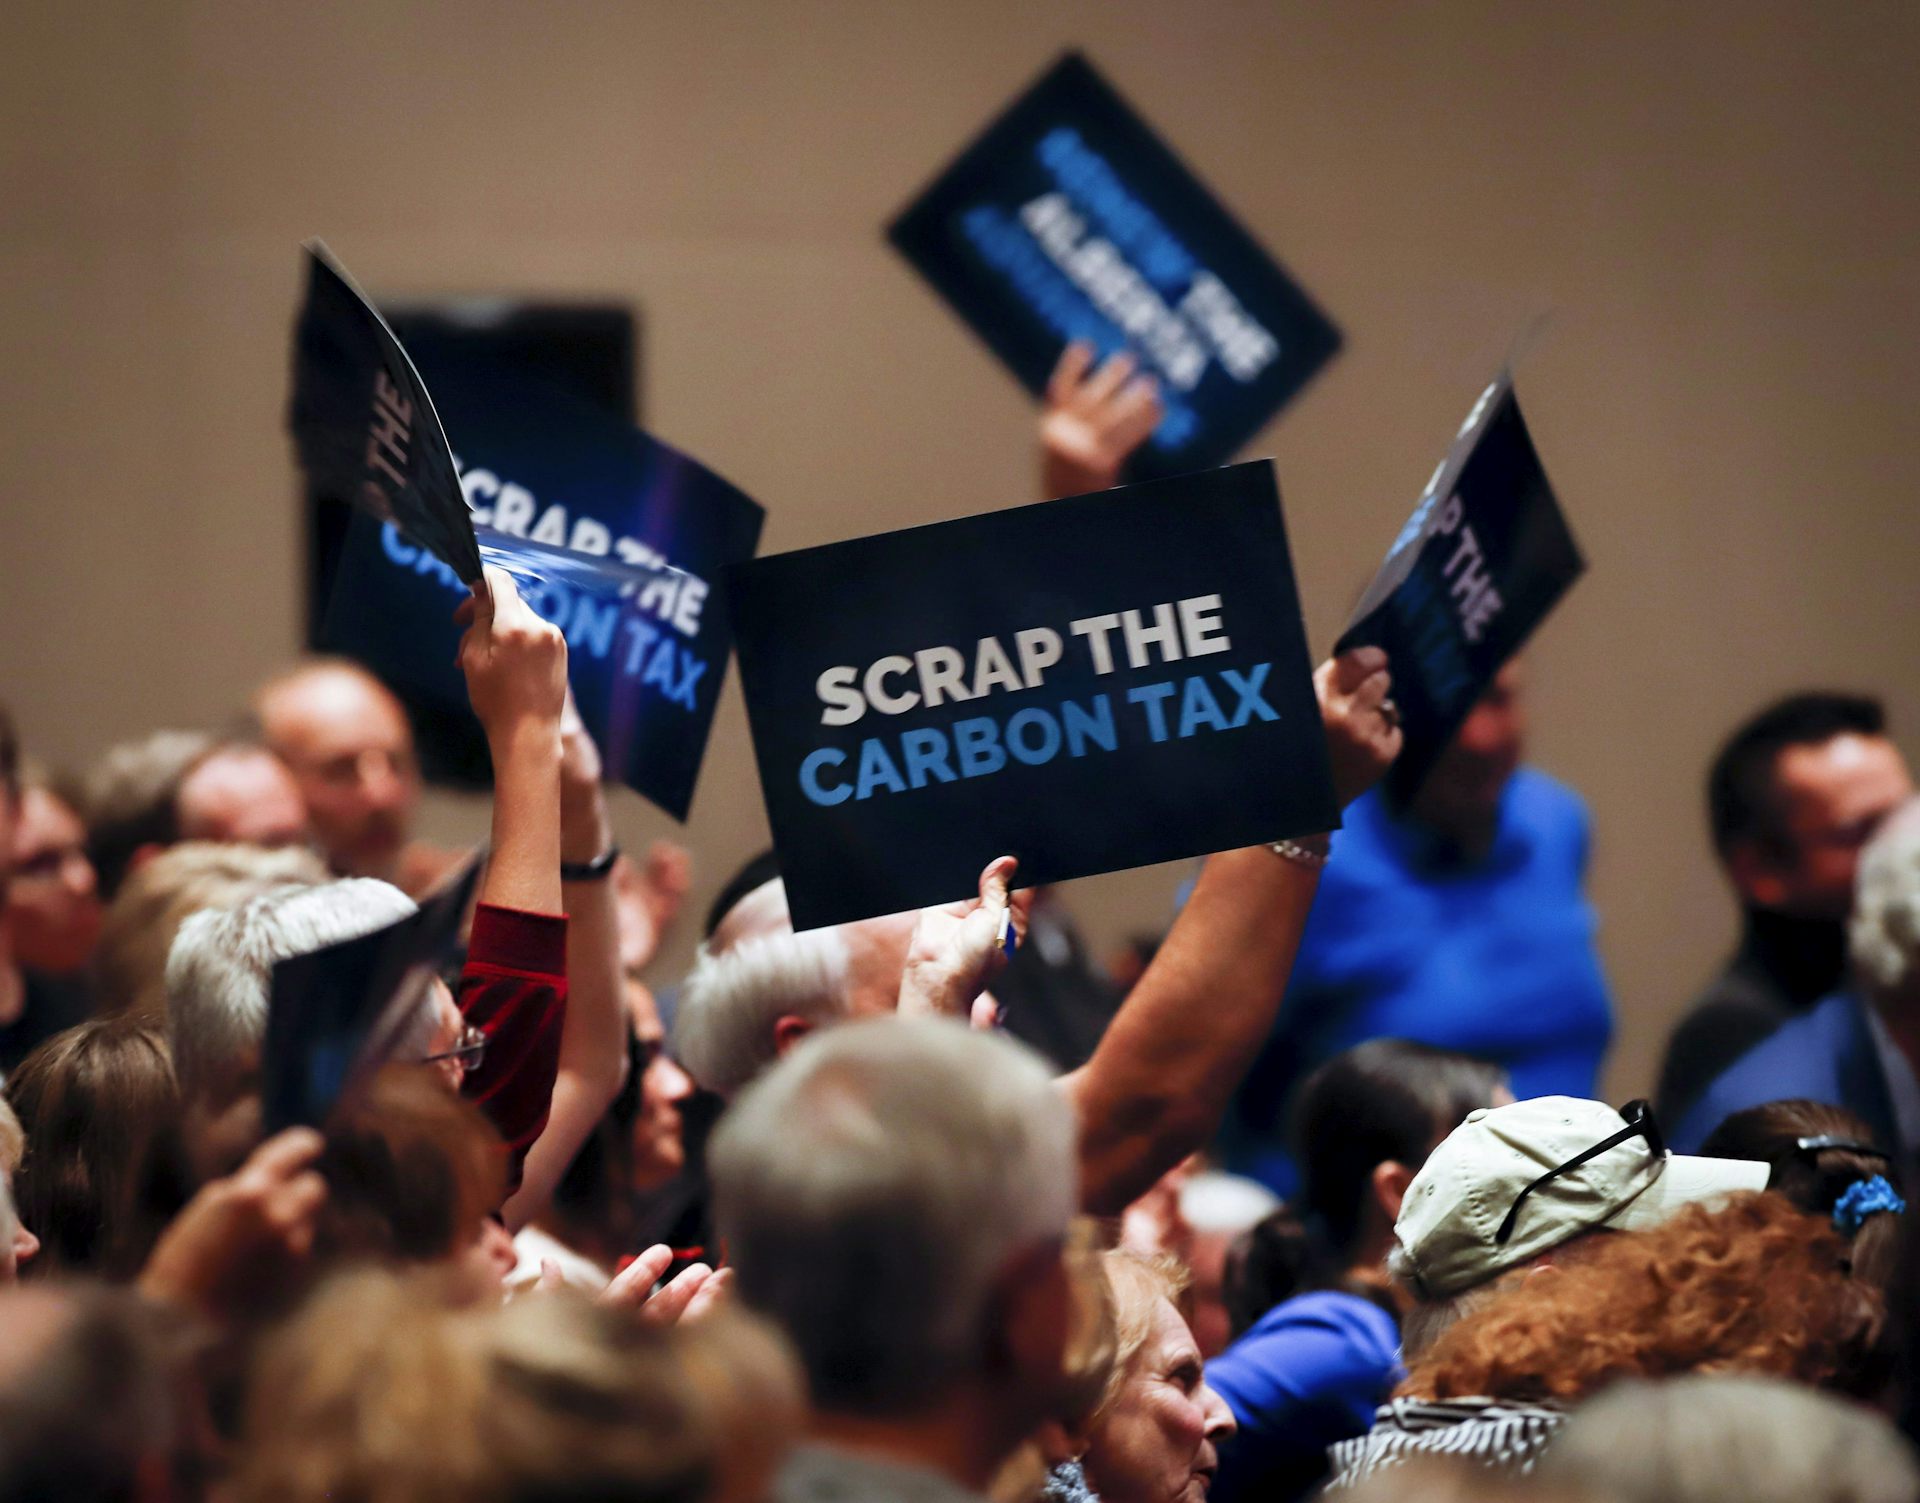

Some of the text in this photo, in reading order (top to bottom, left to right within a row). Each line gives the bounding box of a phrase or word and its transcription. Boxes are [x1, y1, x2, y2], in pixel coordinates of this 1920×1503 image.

[367, 370, 412, 488] THE
[453, 455, 612, 556] CRAP
[1444, 525, 1502, 643] THE
[624, 619, 707, 711] TAX
[816, 593, 1232, 726] SCRAP THE
[799, 662, 1281, 806] CARBON TAX
